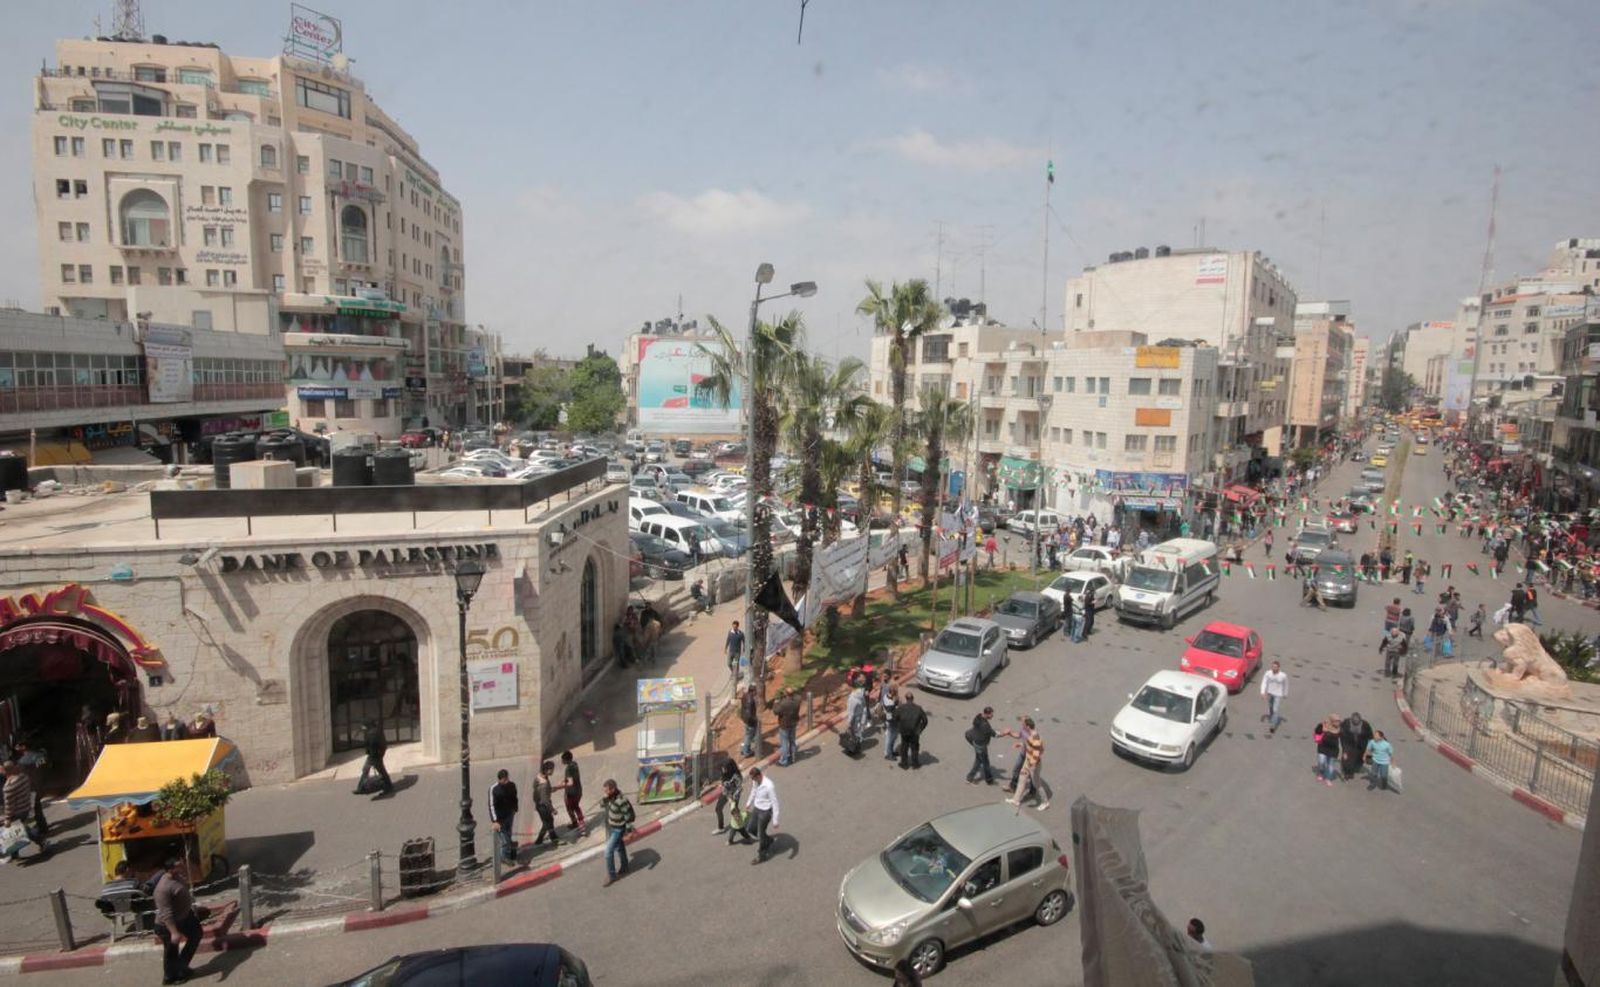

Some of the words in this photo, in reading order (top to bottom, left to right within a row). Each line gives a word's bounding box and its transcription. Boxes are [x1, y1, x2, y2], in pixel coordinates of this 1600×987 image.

[294, 16, 319, 31] City
[294, 26, 333, 45] Center
[58, 115, 88, 130] City
[90, 116, 139, 131] Center
[221, 553, 303, 574] BANK
[311, 550, 351, 569] OF
[358, 542, 497, 565] PALESTINE
[466, 626, 519, 650] 50
